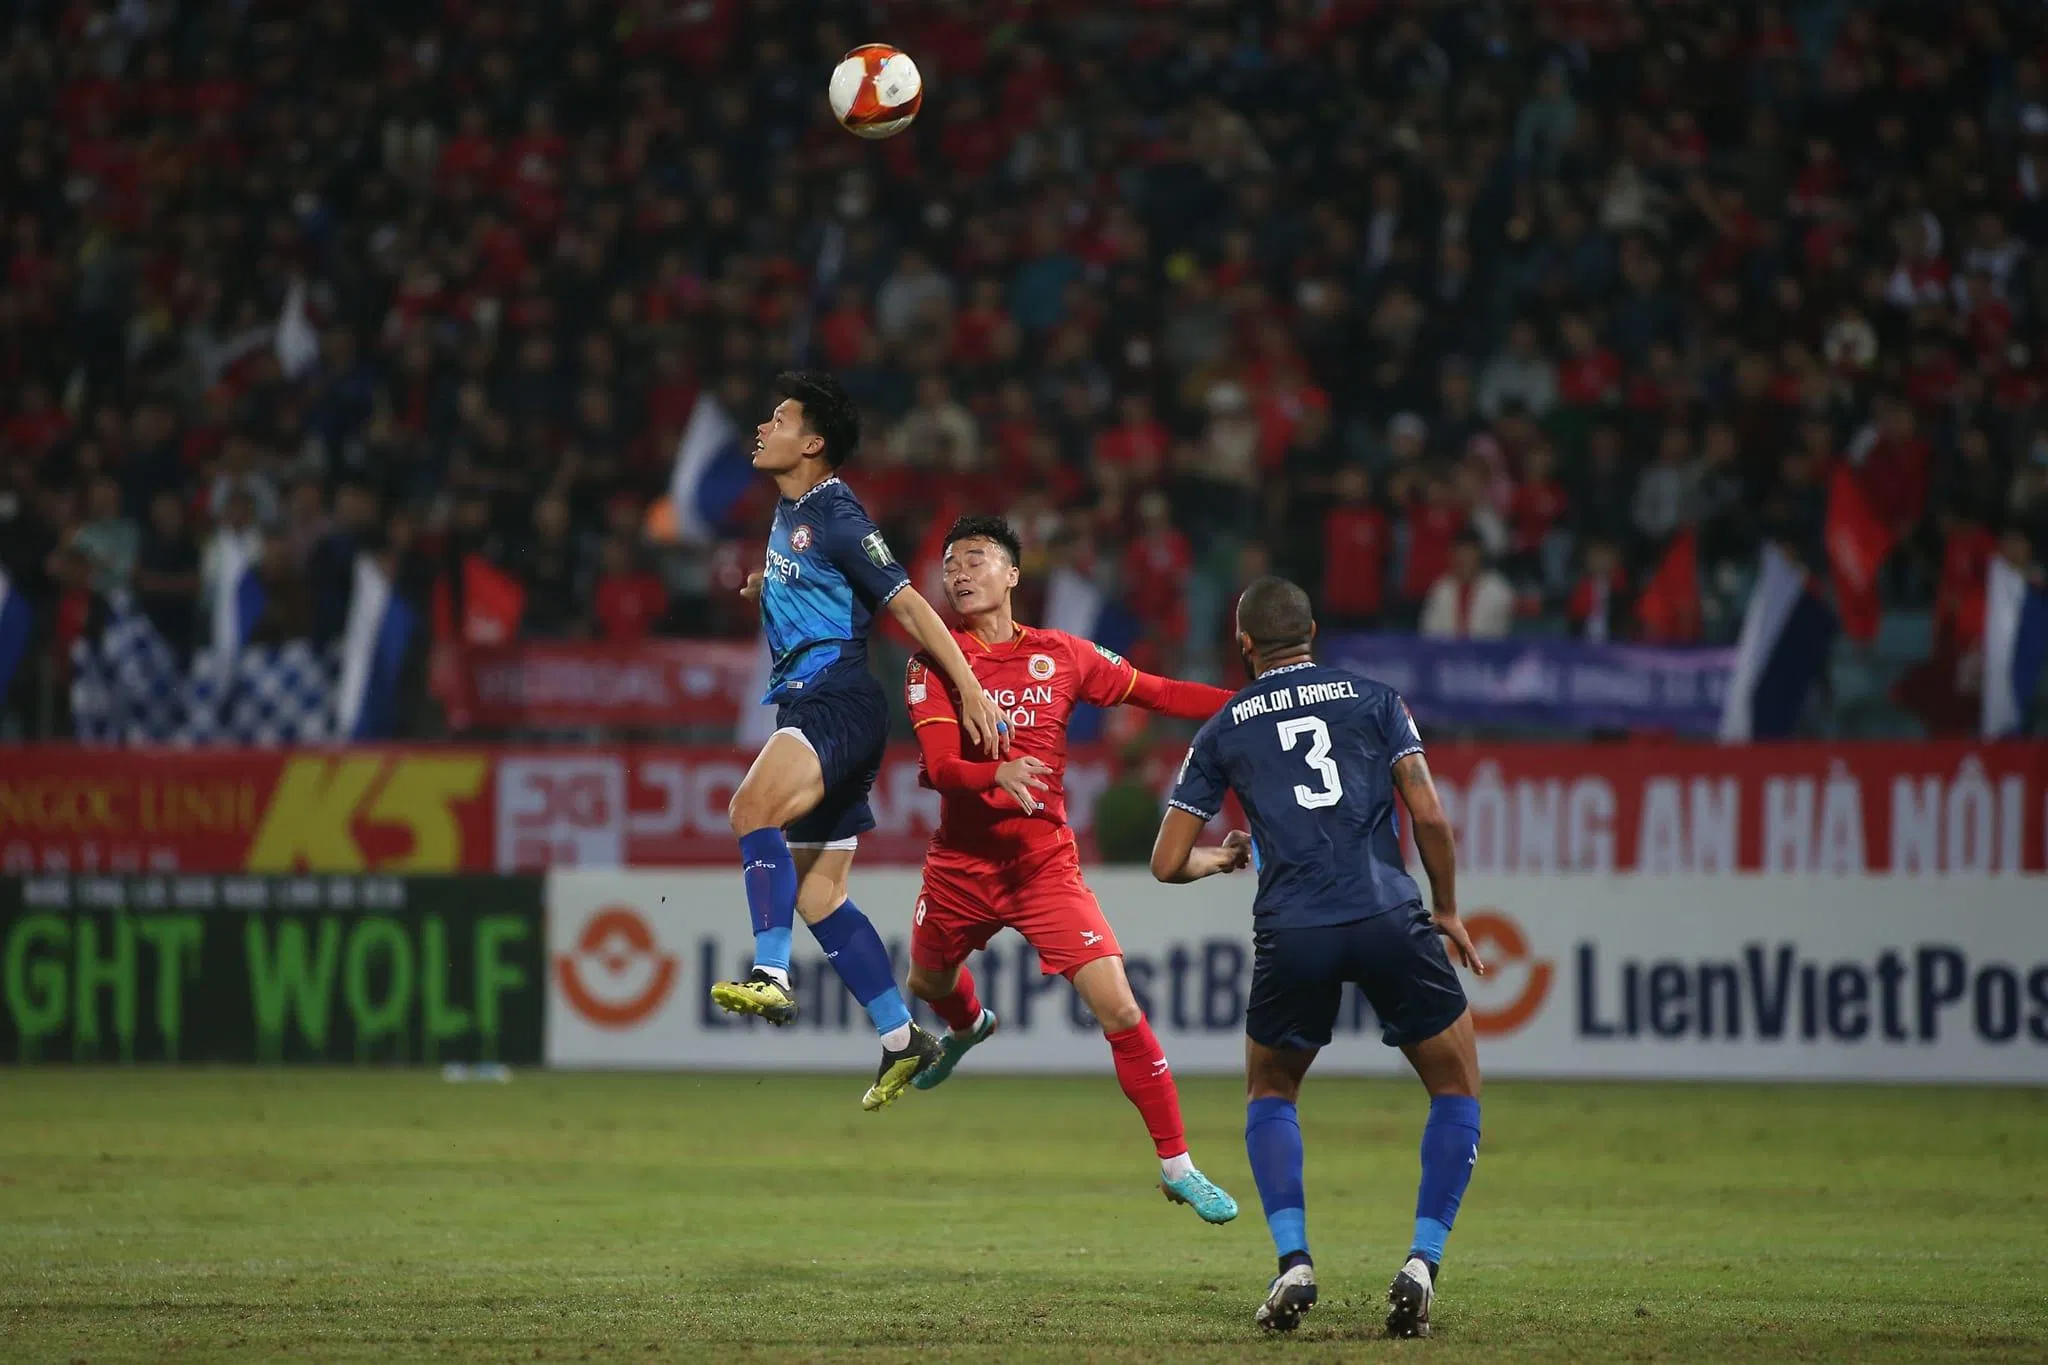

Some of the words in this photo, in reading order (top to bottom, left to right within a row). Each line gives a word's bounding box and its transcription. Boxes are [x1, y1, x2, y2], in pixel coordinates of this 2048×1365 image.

[1006, 705, 1036, 727] ÔI
[1021, 686, 1052, 704] AN
[1232, 688, 1293, 725] MARLON
[1297, 681, 1359, 706] RANGEL
[1276, 715, 1343, 809] 3
[243, 755, 488, 873] K5
[1637, 774, 1738, 875] AN
[1763, 758, 1865, 875] HÀ
[5, 912, 204, 1042] GHT
[244, 910, 529, 1050] WOLF
